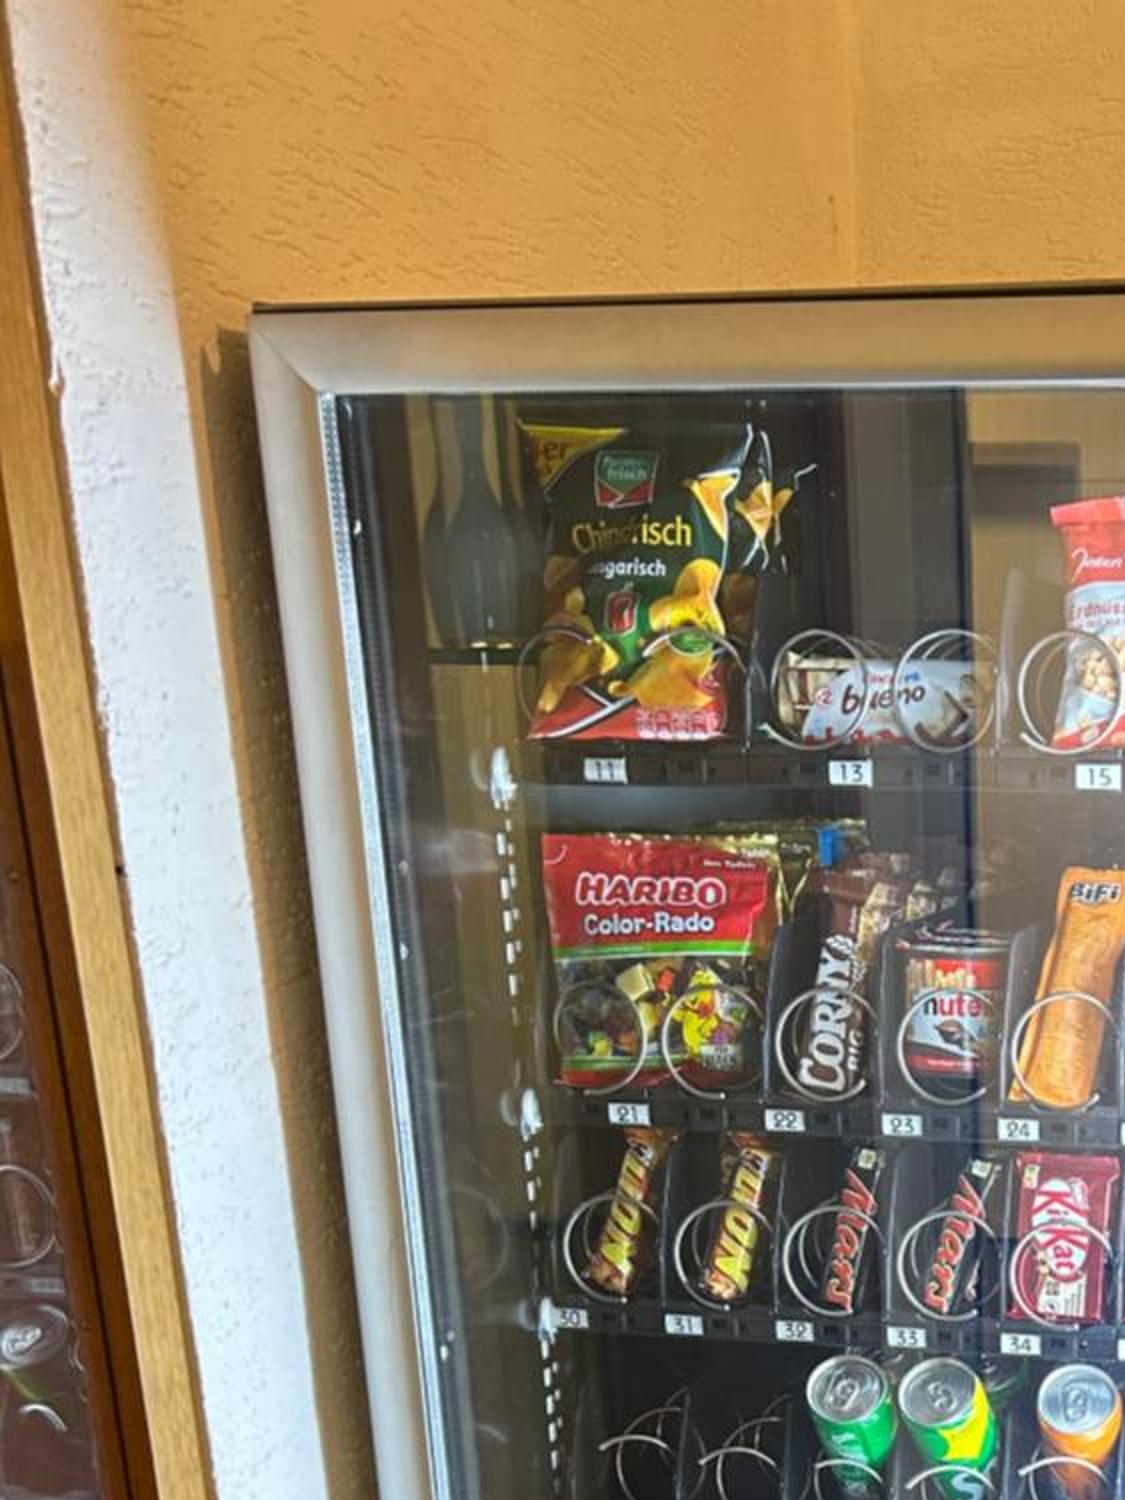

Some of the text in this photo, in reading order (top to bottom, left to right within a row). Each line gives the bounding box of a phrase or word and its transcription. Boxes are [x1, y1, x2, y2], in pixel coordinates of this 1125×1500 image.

[571, 514, 693, 554] Chiisch
[576, 872, 728, 909] HARIBO
[584, 911, 715, 936] Color-Rado
[799, 946, 855, 1091] CORNY
[922, 992, 984, 1018] nute
[825, 1167, 879, 1313] Mars
[925, 1173, 986, 1313] Mars
[1031, 1190, 1090, 1271] KiKat
